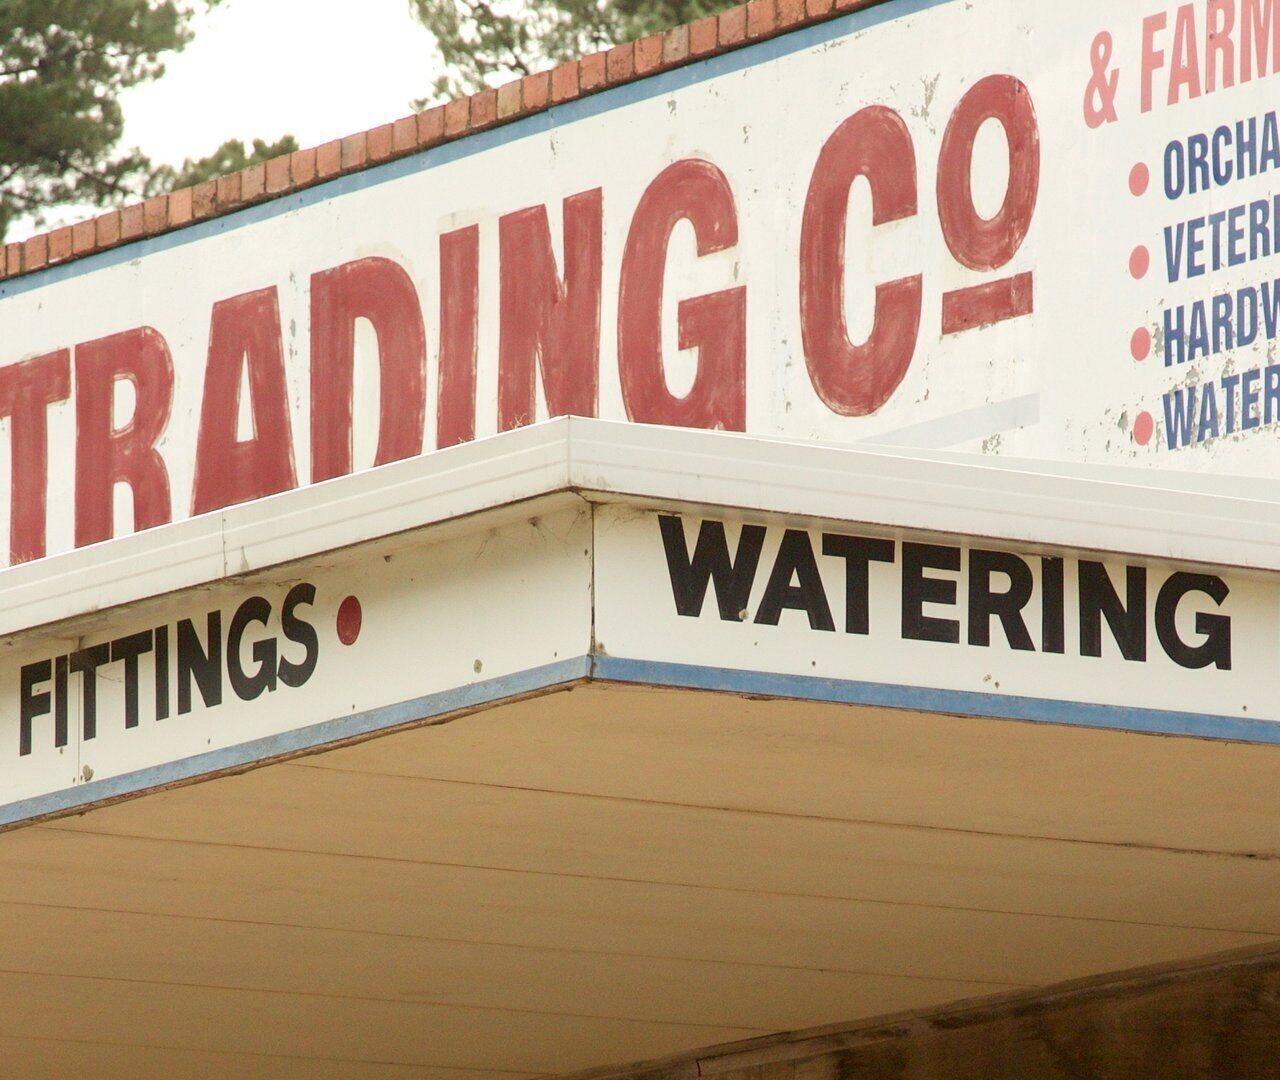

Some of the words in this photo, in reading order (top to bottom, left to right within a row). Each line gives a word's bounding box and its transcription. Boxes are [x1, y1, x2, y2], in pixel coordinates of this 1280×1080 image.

[1084, 32, 1119, 128] &
[19, 583, 320, 756] FITTINGS
[657, 514, 1232, 671] WATERING
